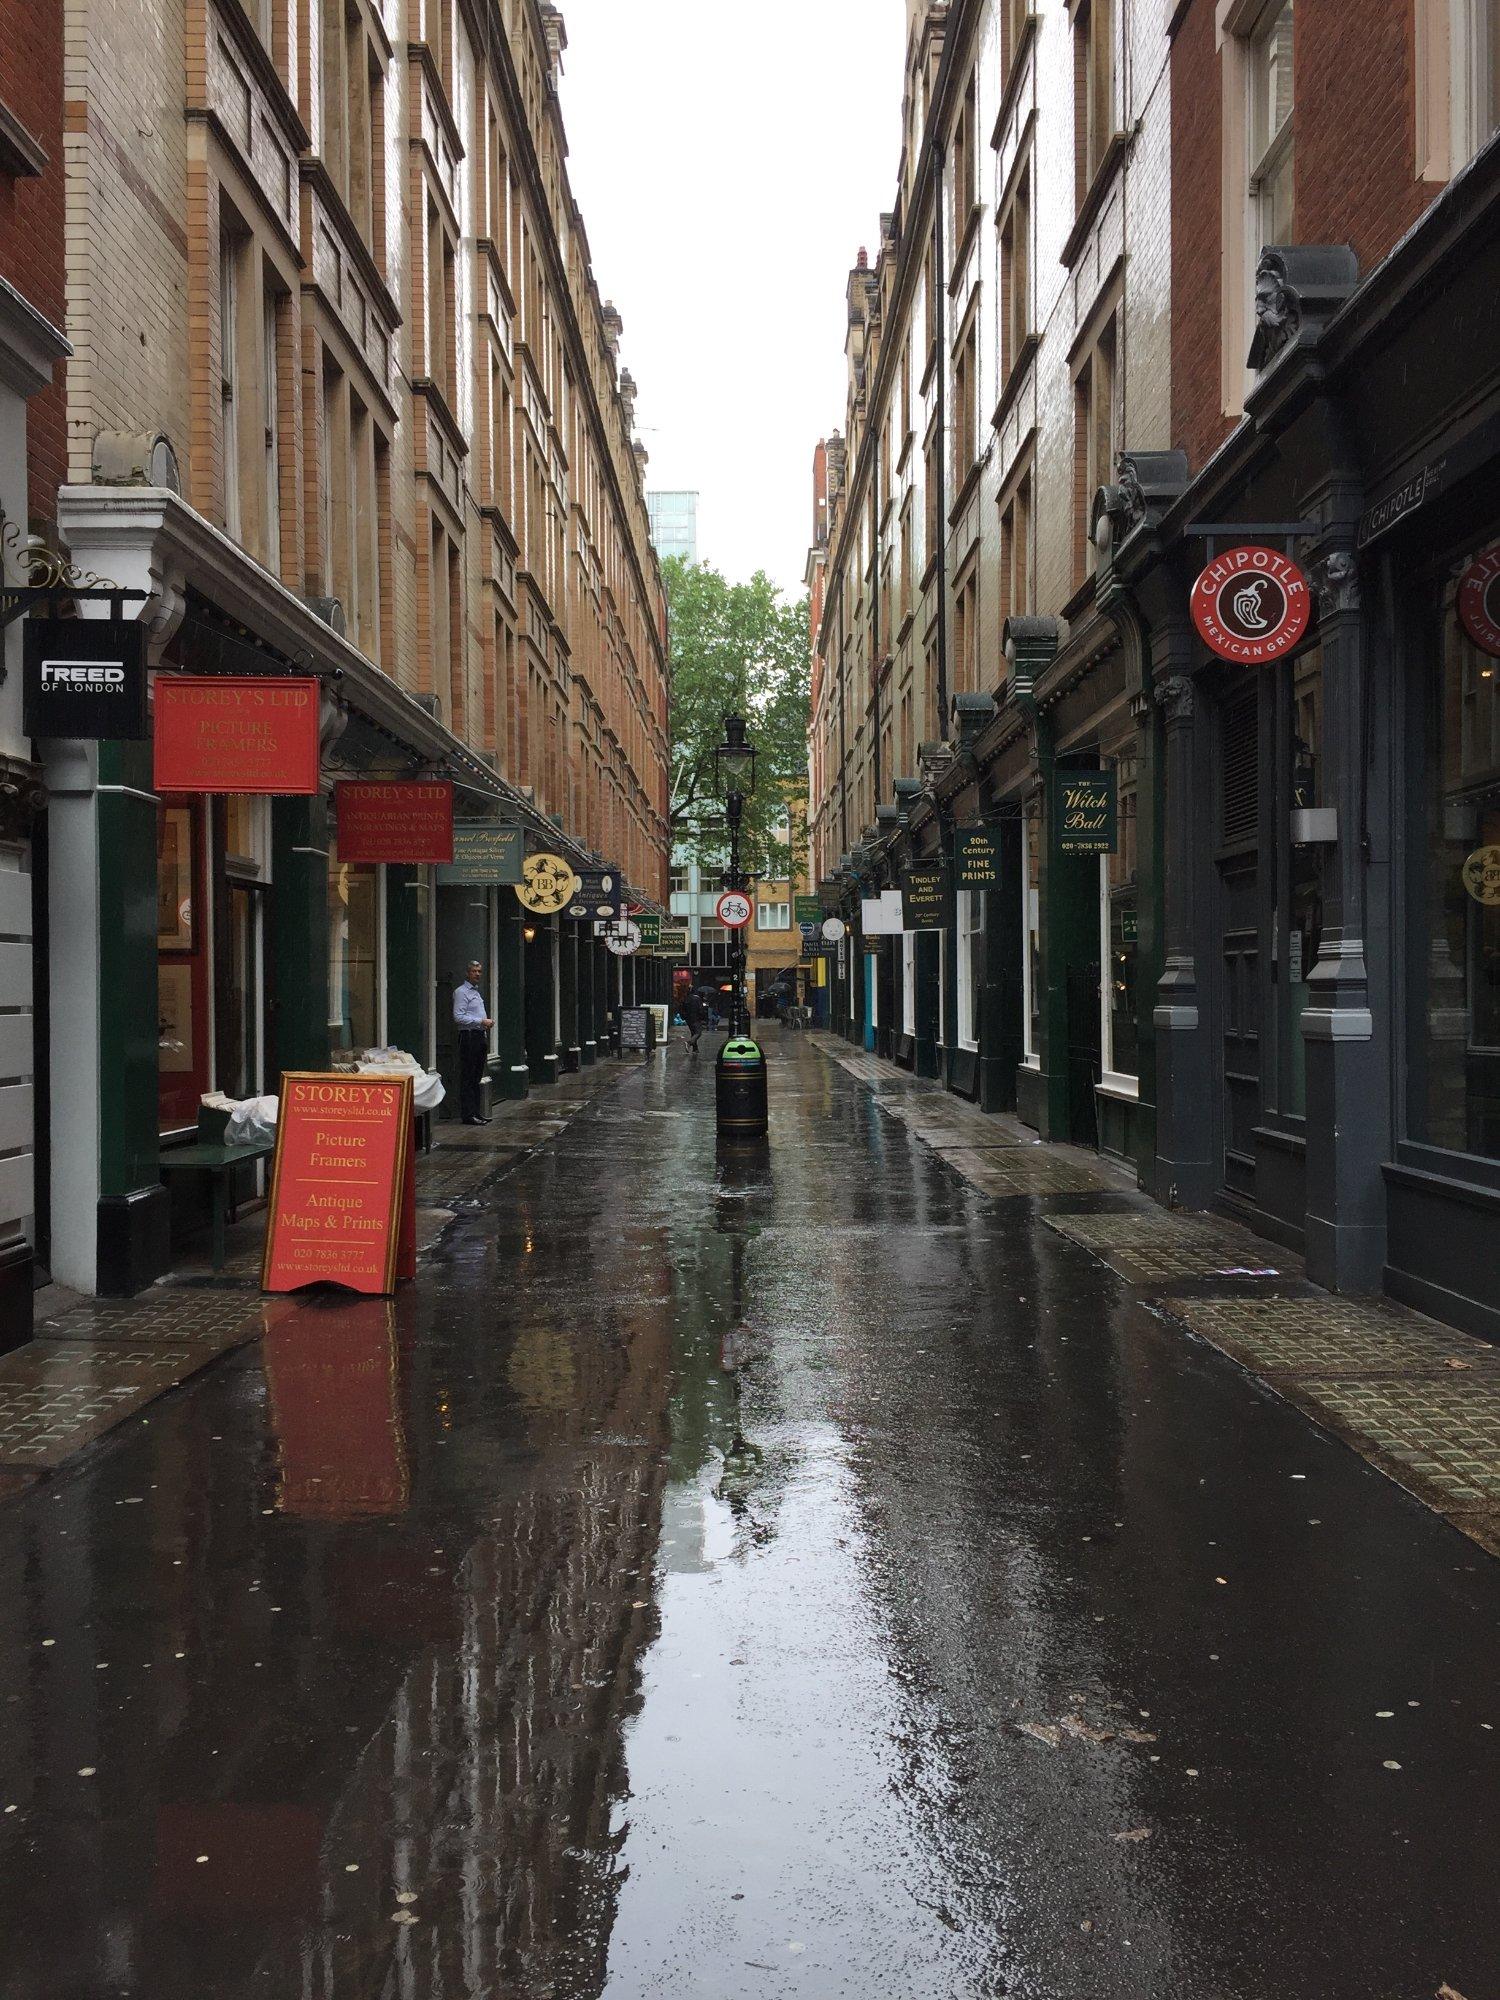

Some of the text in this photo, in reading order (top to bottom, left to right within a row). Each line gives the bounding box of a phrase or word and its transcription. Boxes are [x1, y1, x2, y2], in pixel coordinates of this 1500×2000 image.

[1372, 477, 1423, 529] CHIPOTLE
[1201, 552, 1303, 595] CHIPOTLE
[1203, 616, 1301, 656] MEXICAN GRILL
[42, 661, 125, 682] FREED
[42, 683, 124, 693] OF LONDON
[270, 690, 308, 706] LTD
[200, 720, 273, 735] PICTURE
[418, 786, 447, 800] LTD
[1063, 789, 1108, 808] Witch
[1064, 811, 1107, 829] Ball
[970, 837, 988, 845] 20th
[962, 846, 995, 855] Century
[967, 860, 990, 868] FINE
[909, 876, 941, 885] TINDLEY
[961, 871, 996, 880] PRINTS
[537, 878, 554, 890] BB
[909, 894, 943, 903] EVERETT
[295, 1085, 394, 1104] STOREY'S
[293, 1105, 393, 1117] www.storeysltd.co.uk
[316, 1132, 367, 1148] Picture
[310, 1153, 367, 1168] Framers
[306, 1194, 363, 1211] Antique
[281, 1213, 384, 1230] Maps & Prints
[294, 1248, 312, 1258] 020
[315, 1249, 338, 1260] 7836
[277, 1262, 378, 1274] www.storeysltd.co.uk
